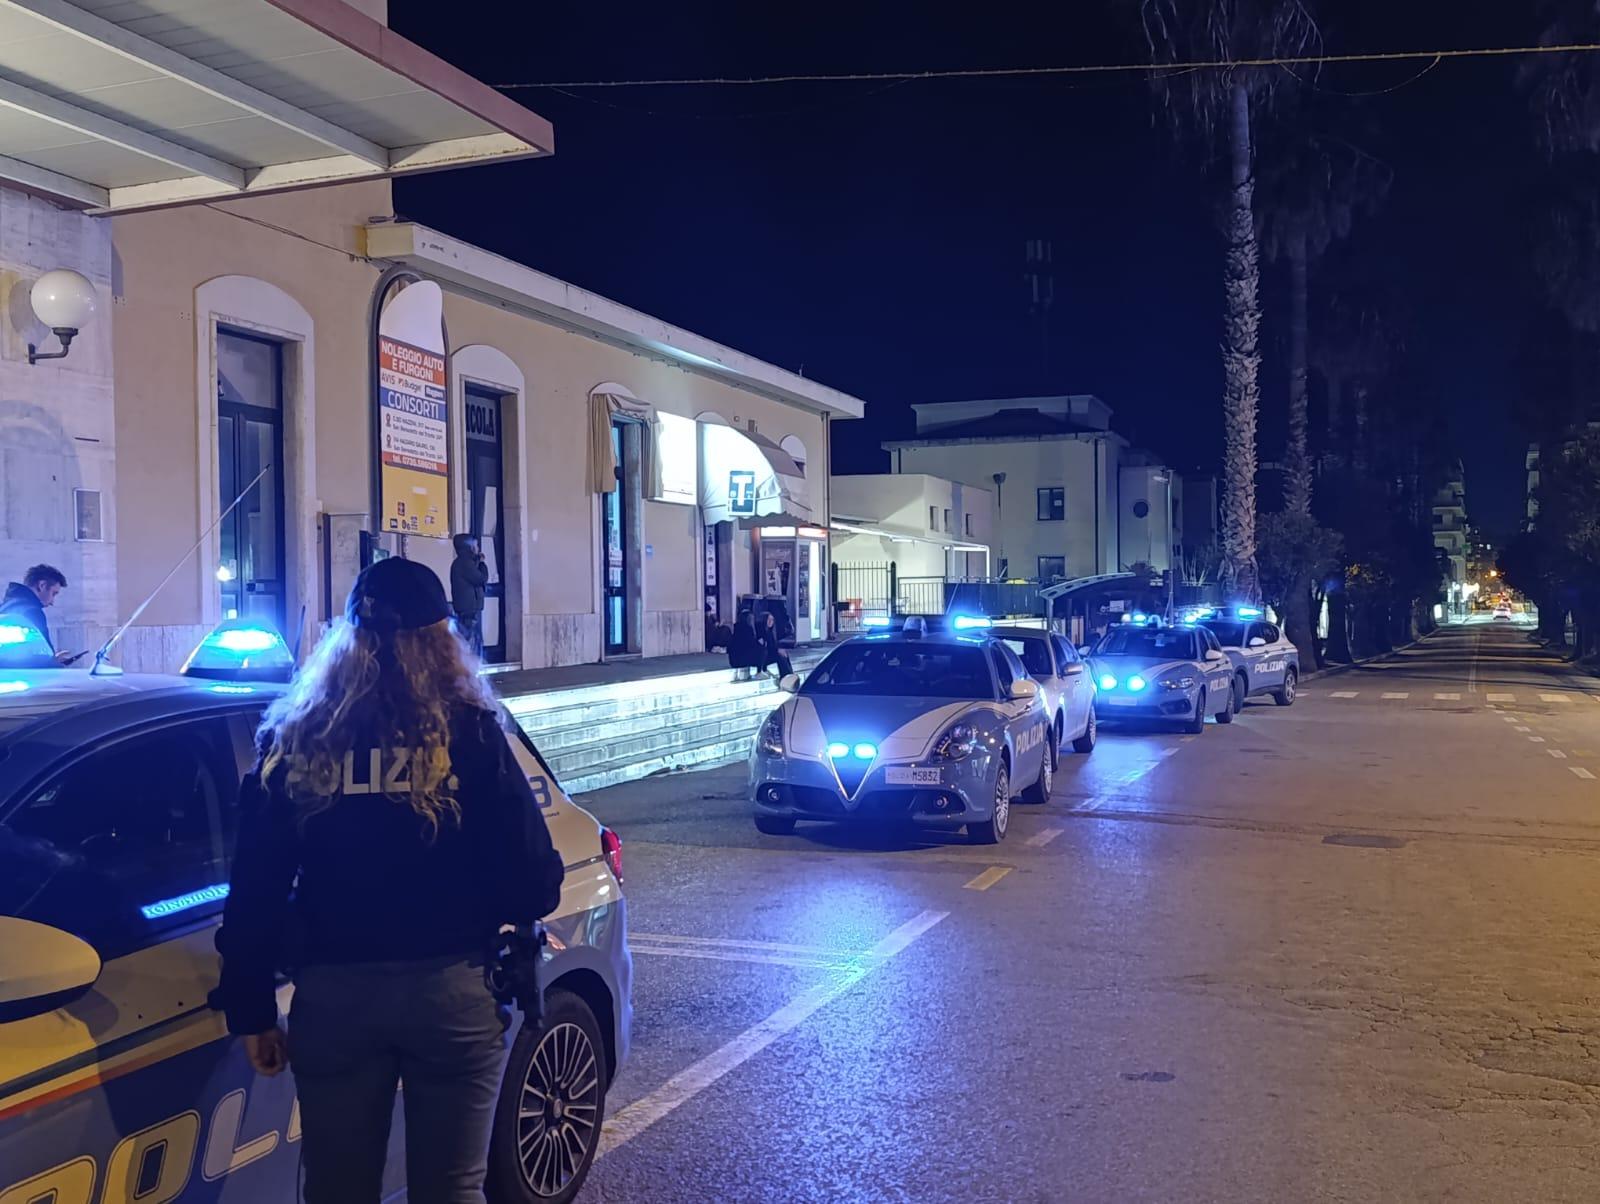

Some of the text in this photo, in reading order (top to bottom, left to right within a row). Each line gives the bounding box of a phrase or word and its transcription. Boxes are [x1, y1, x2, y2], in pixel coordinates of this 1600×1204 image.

[381, 341, 444, 372] NOLEGGIO AUTO
[381, 371, 396, 385] AVIS
[392, 359, 433, 381] E FURGONI
[387, 391, 439, 419] CONSORTI
